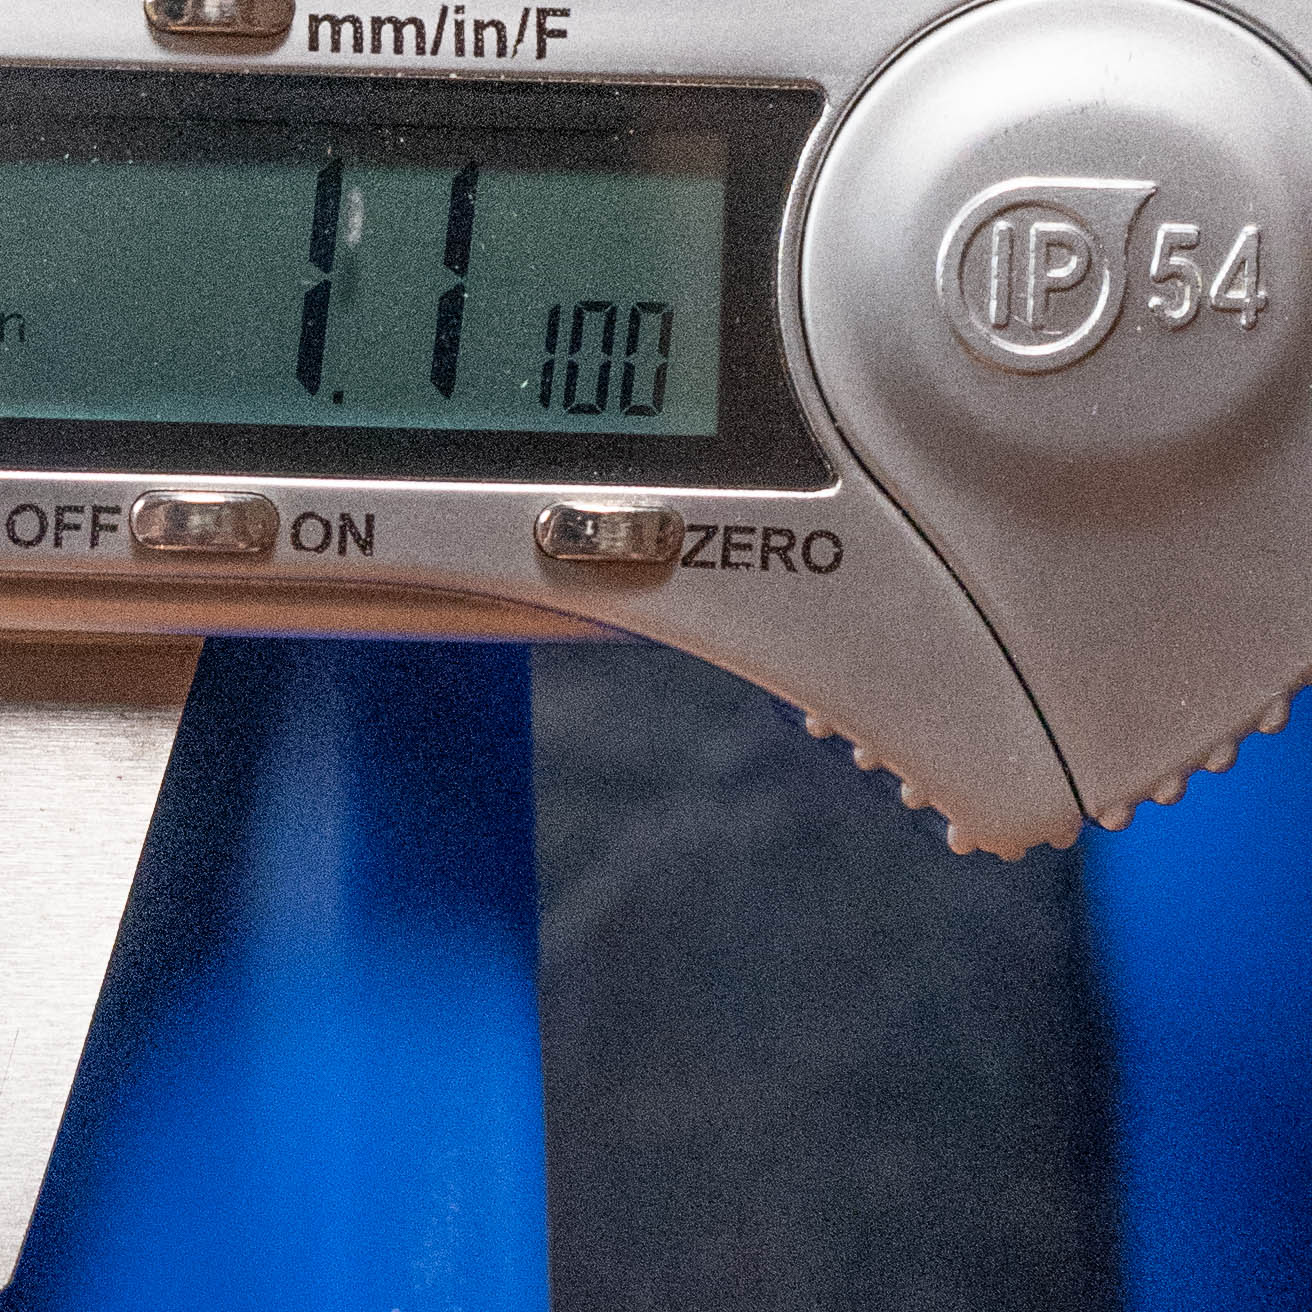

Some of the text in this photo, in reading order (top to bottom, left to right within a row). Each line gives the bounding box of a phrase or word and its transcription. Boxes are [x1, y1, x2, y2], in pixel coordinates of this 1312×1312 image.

[308, 4, 572, 60] mm/in/F
[988, 221, 1267, 332] IP 54
[5, 504, 122, 549] OFF
[290, 511, 376, 557] ON
[680, 521, 845, 575] ZERO
